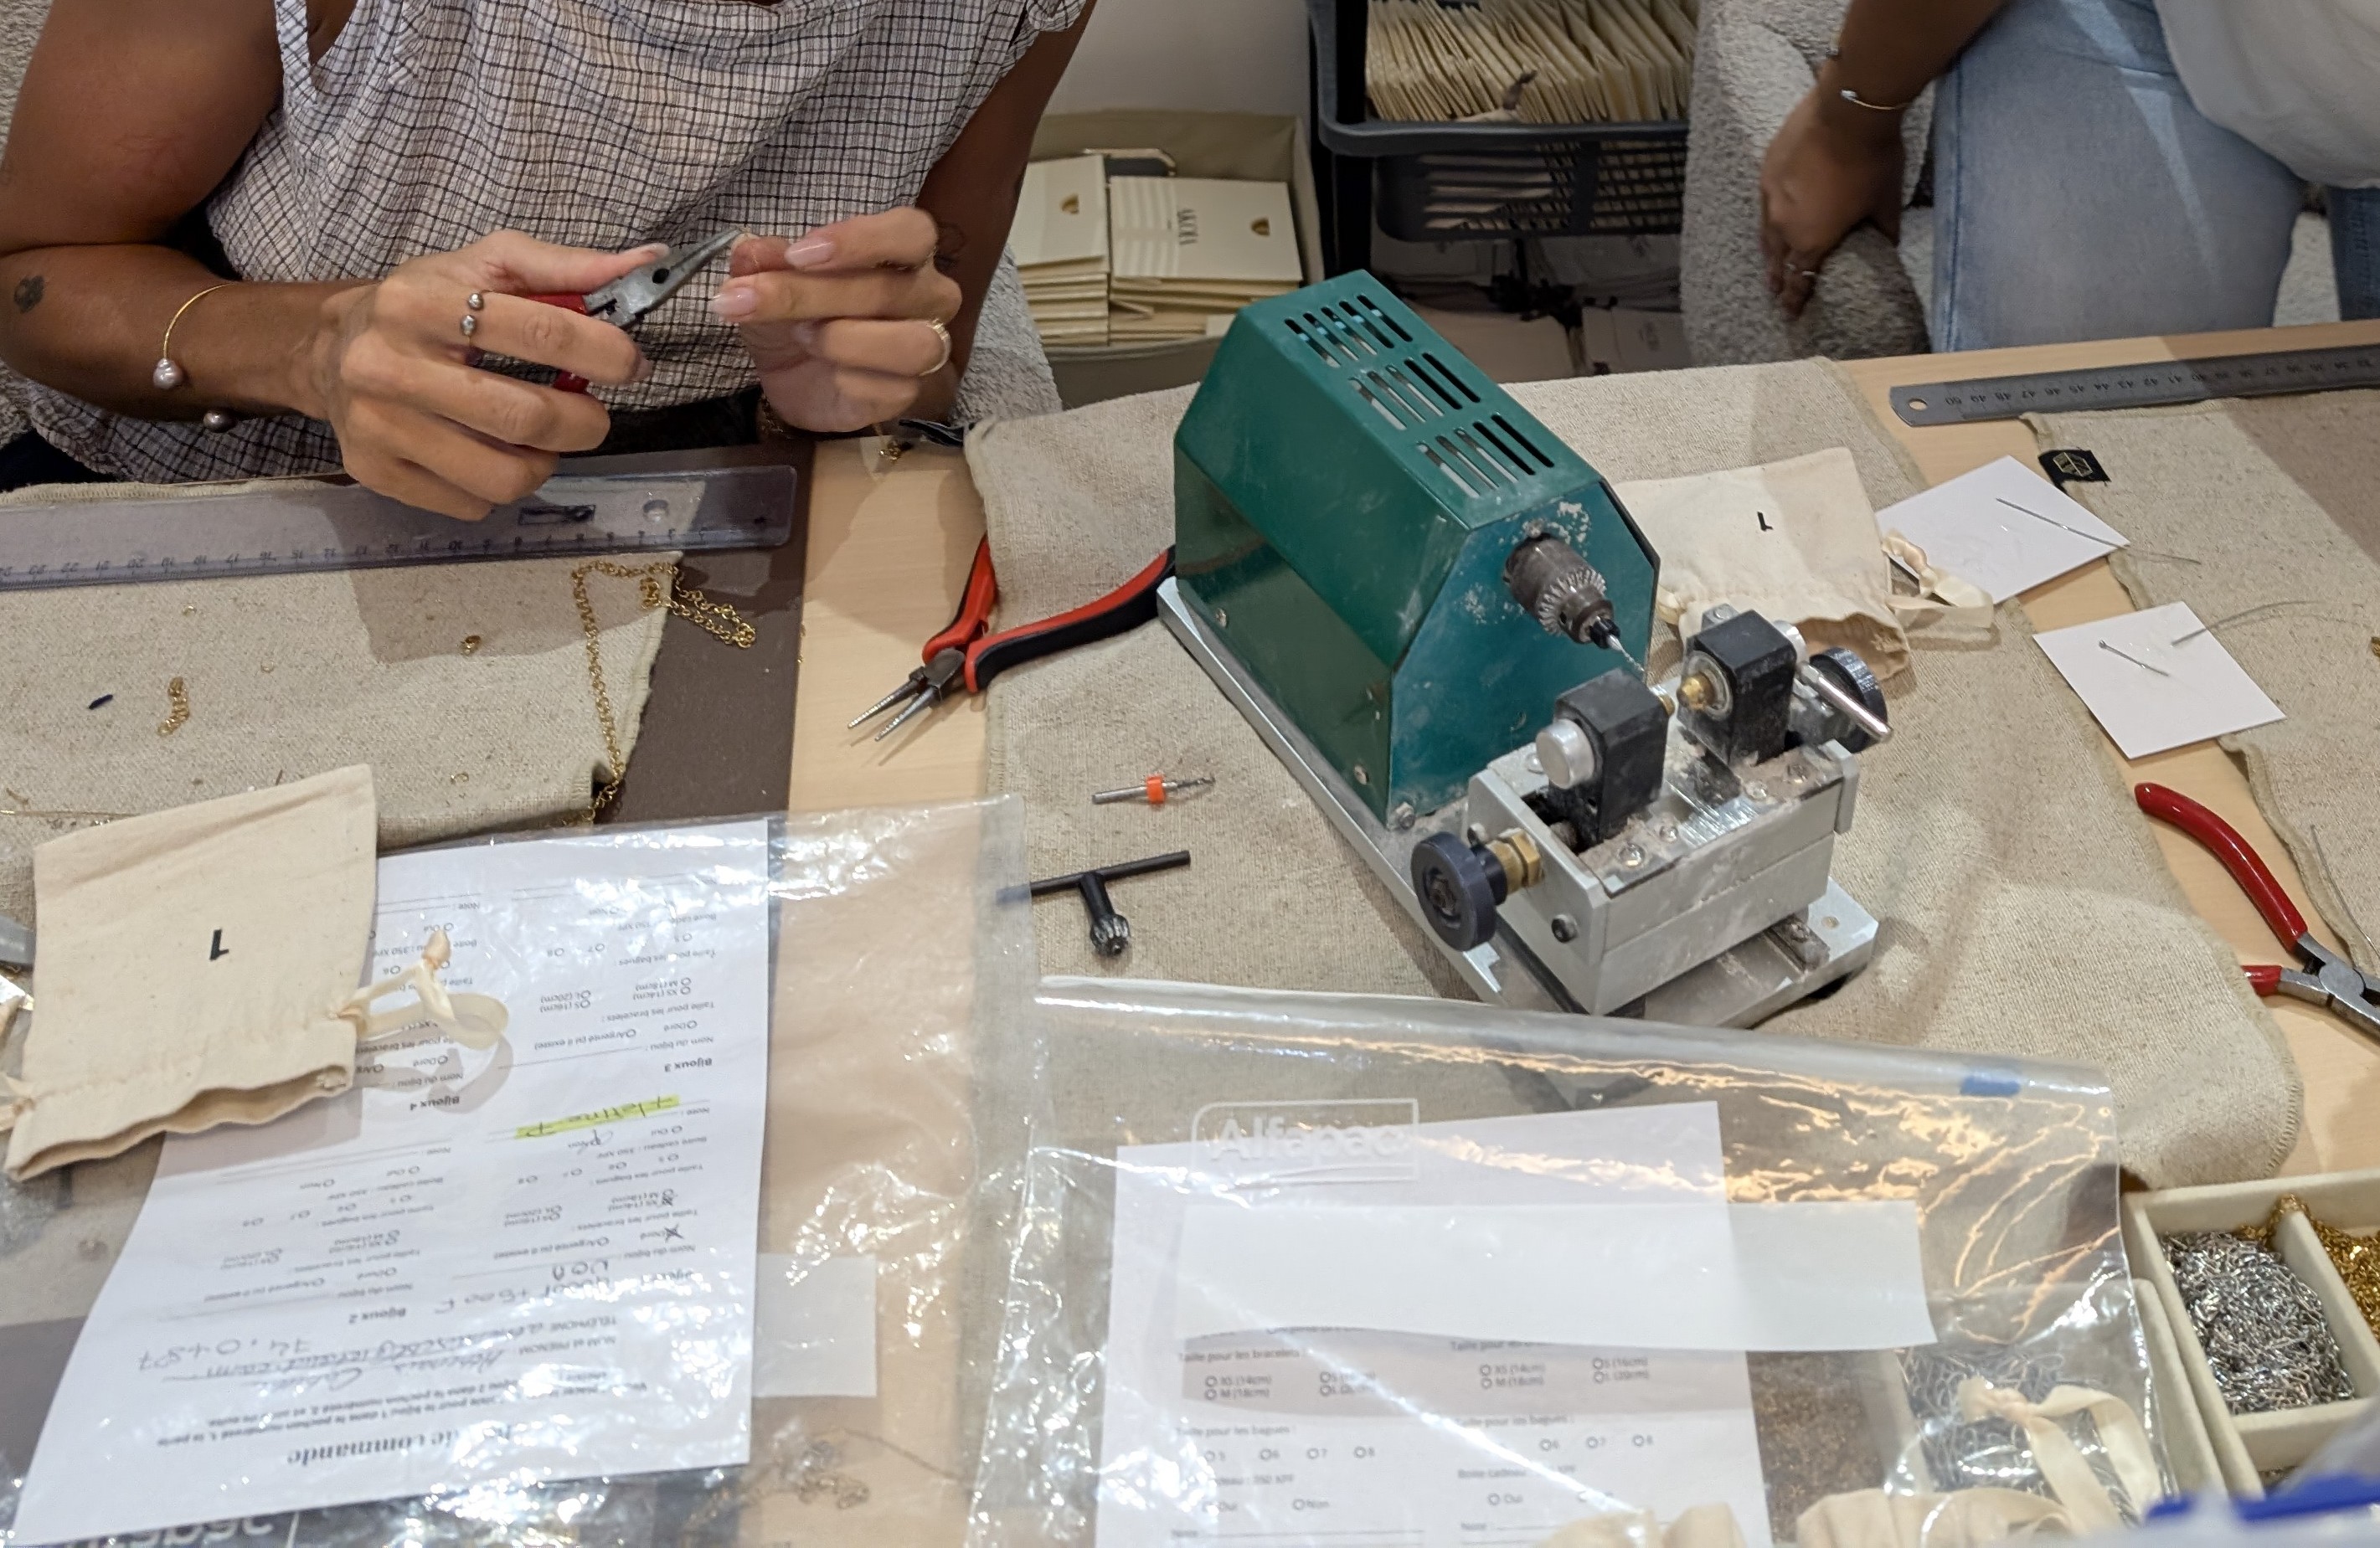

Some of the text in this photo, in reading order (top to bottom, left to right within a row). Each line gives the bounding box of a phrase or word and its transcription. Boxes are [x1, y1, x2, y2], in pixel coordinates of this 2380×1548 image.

[2094, 383, 2110, 391] 44
[1970, 394, 1986, 404] 49
[209, 928, 229, 962] 1
[690, 1036, 713, 1047] Nom
[663, 1057, 713, 1073] Bijoux 3
[398, 1072, 463, 1089] Nom du bijou
[410, 1094, 460, 1111] Bijoux 4
[286, 1434, 425, 1467] commande
